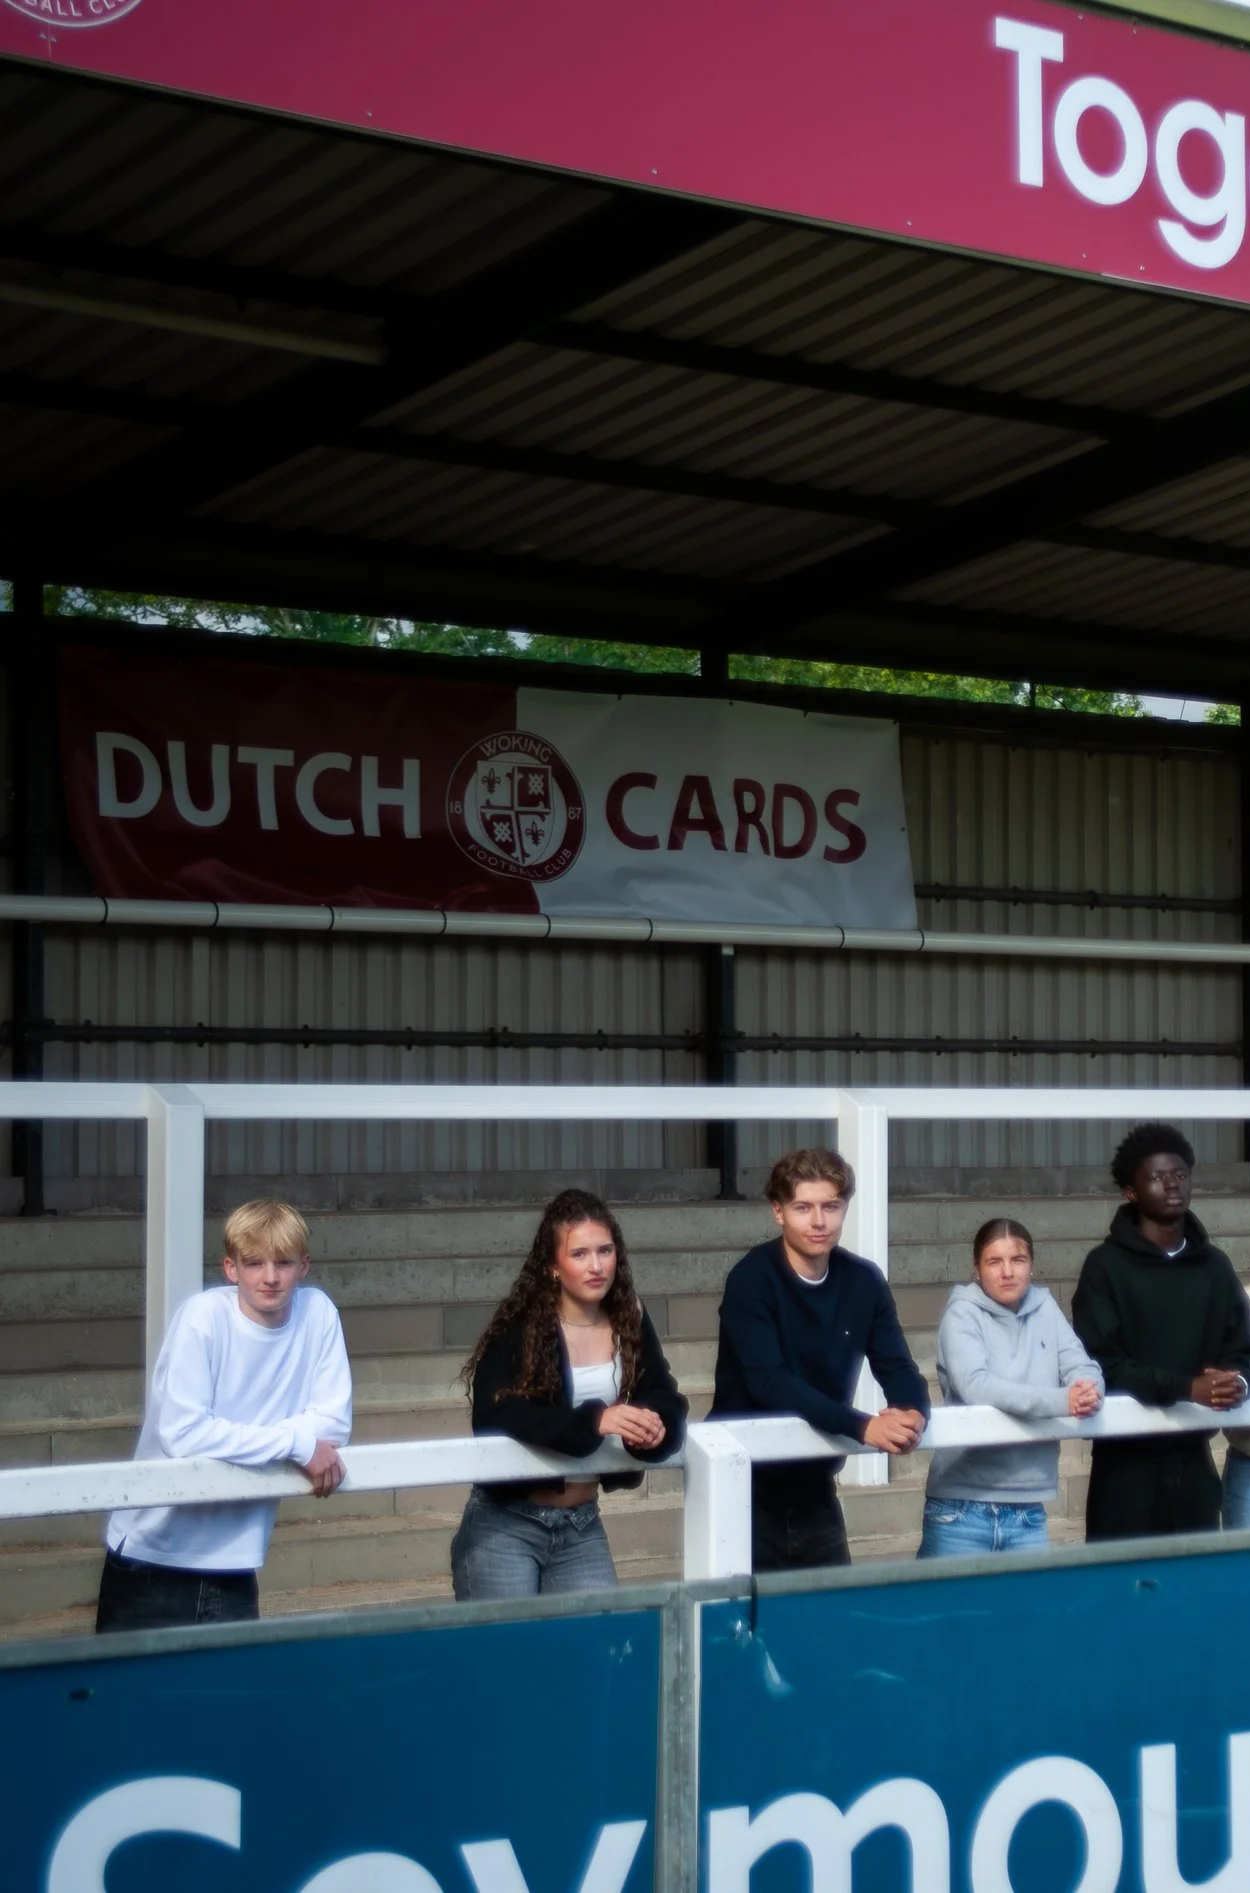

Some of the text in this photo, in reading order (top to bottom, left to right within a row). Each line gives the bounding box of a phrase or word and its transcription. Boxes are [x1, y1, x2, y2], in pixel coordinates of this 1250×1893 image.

[479, 735, 552, 763] WOKING
[95, 731, 868, 864] DUTCH CARDS
[468, 844, 573, 878] FOOTBALL CLUB
